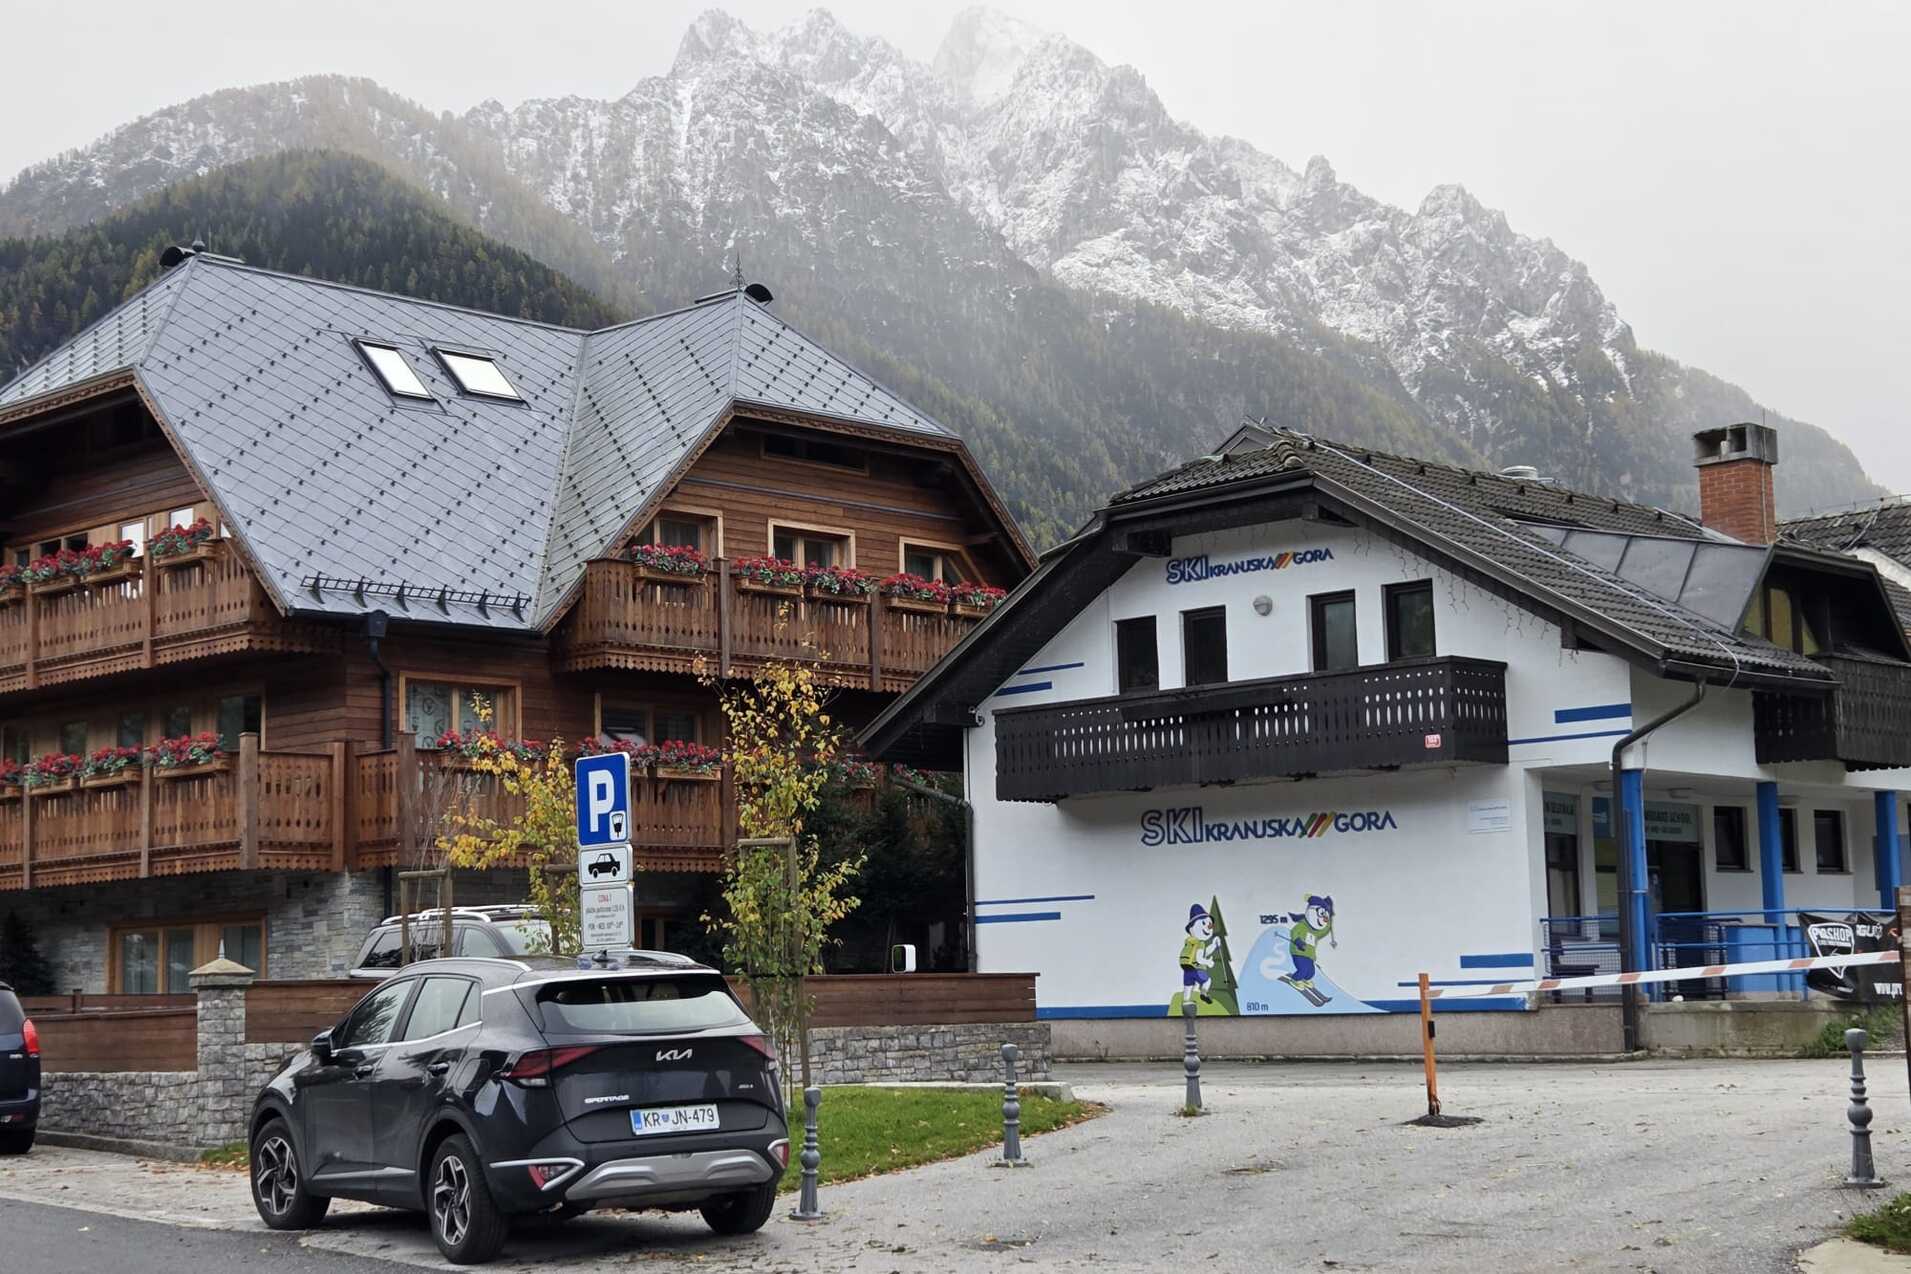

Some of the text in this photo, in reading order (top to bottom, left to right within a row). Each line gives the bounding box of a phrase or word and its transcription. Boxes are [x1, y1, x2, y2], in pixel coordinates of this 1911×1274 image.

[1166, 548, 1334, 585] SKI KRANJSKA GORA
[588, 769, 615, 833] P
[1140, 806, 1398, 847] SKI KRANJSKA GORA
[1261, 1003, 1269, 1011] m
[656, 1049, 692, 1061] KIA
[584, 1095, 630, 1103] SPORTAGE
[643, 1109, 715, 1127] KR JN-479
